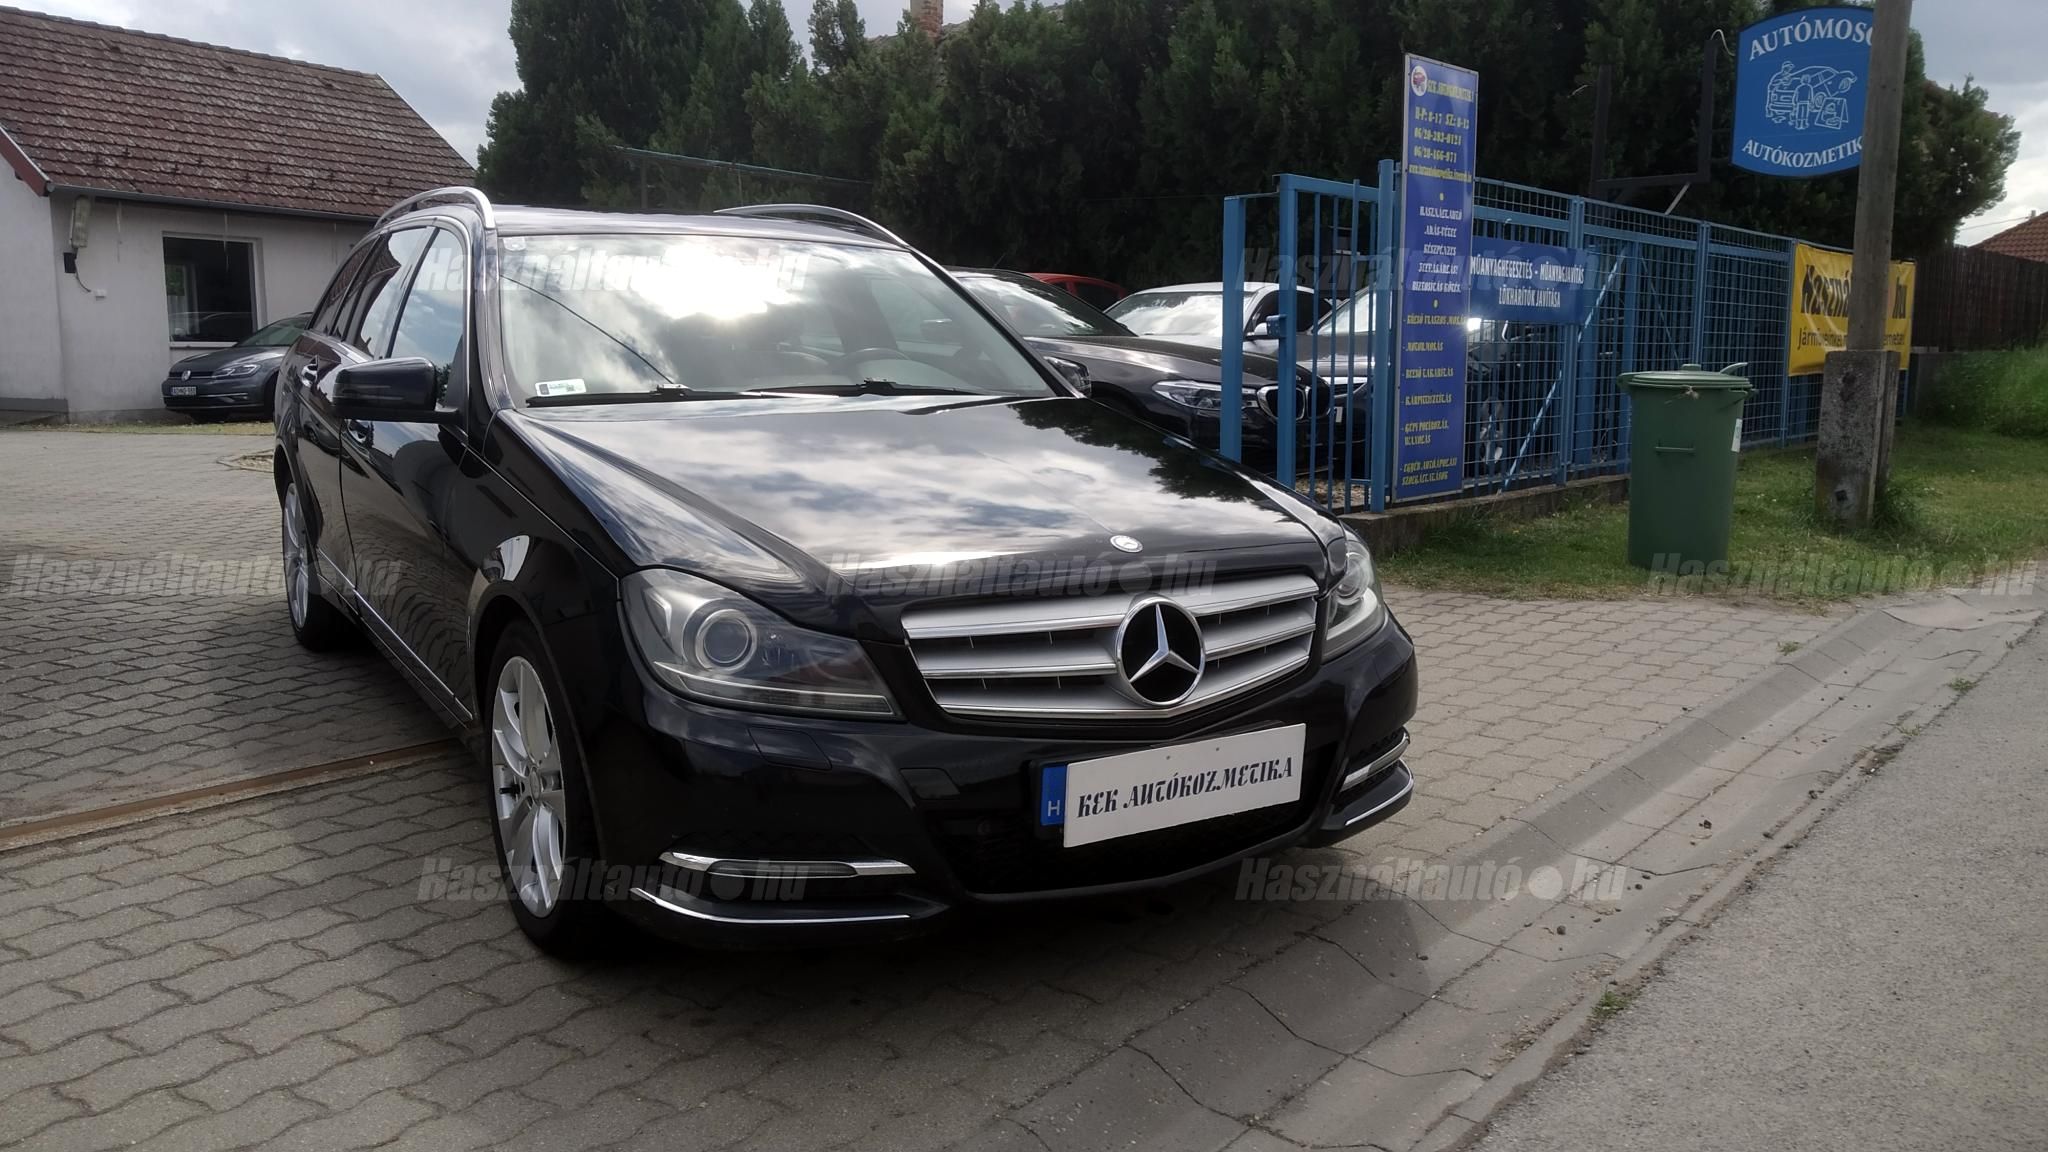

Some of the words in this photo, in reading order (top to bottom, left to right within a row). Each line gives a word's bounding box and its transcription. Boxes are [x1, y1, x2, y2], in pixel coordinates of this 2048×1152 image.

[1749, 15, 1873, 61] AUTÓMOS
[1742, 136, 1863, 168] AUTÓKOZMETIK
[1047, 799, 1061, 817] H
[1077, 788, 1118, 818] KEK
